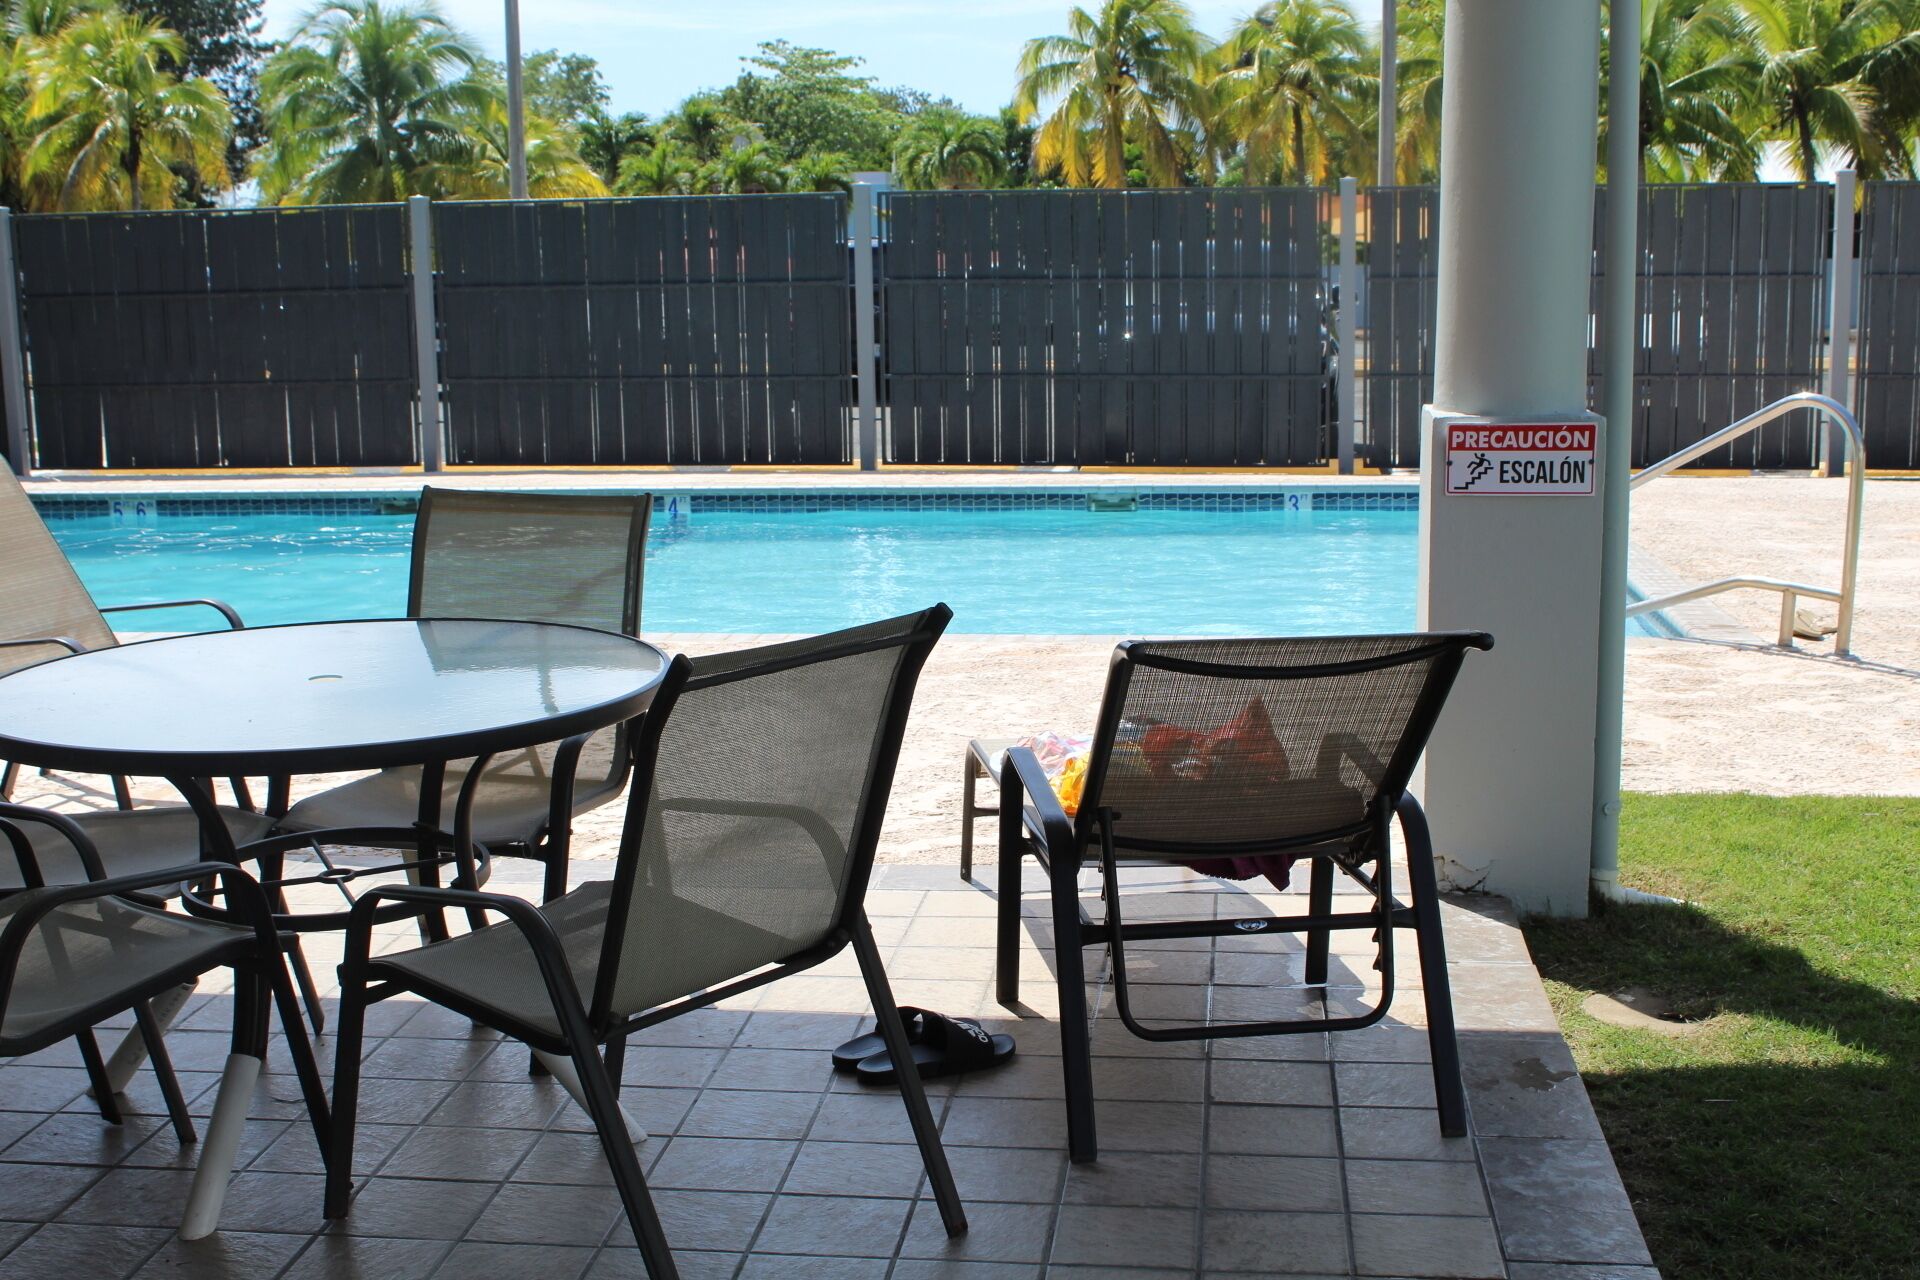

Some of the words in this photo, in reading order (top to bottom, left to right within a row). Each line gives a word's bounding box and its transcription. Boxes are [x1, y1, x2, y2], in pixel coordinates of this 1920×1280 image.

[1451, 426, 1590, 448] PRECAUCIÓN
[1500, 456, 1586, 484] ESCALÓN
[668, 497, 679, 513] 4
[1289, 494, 1299, 511] 3
